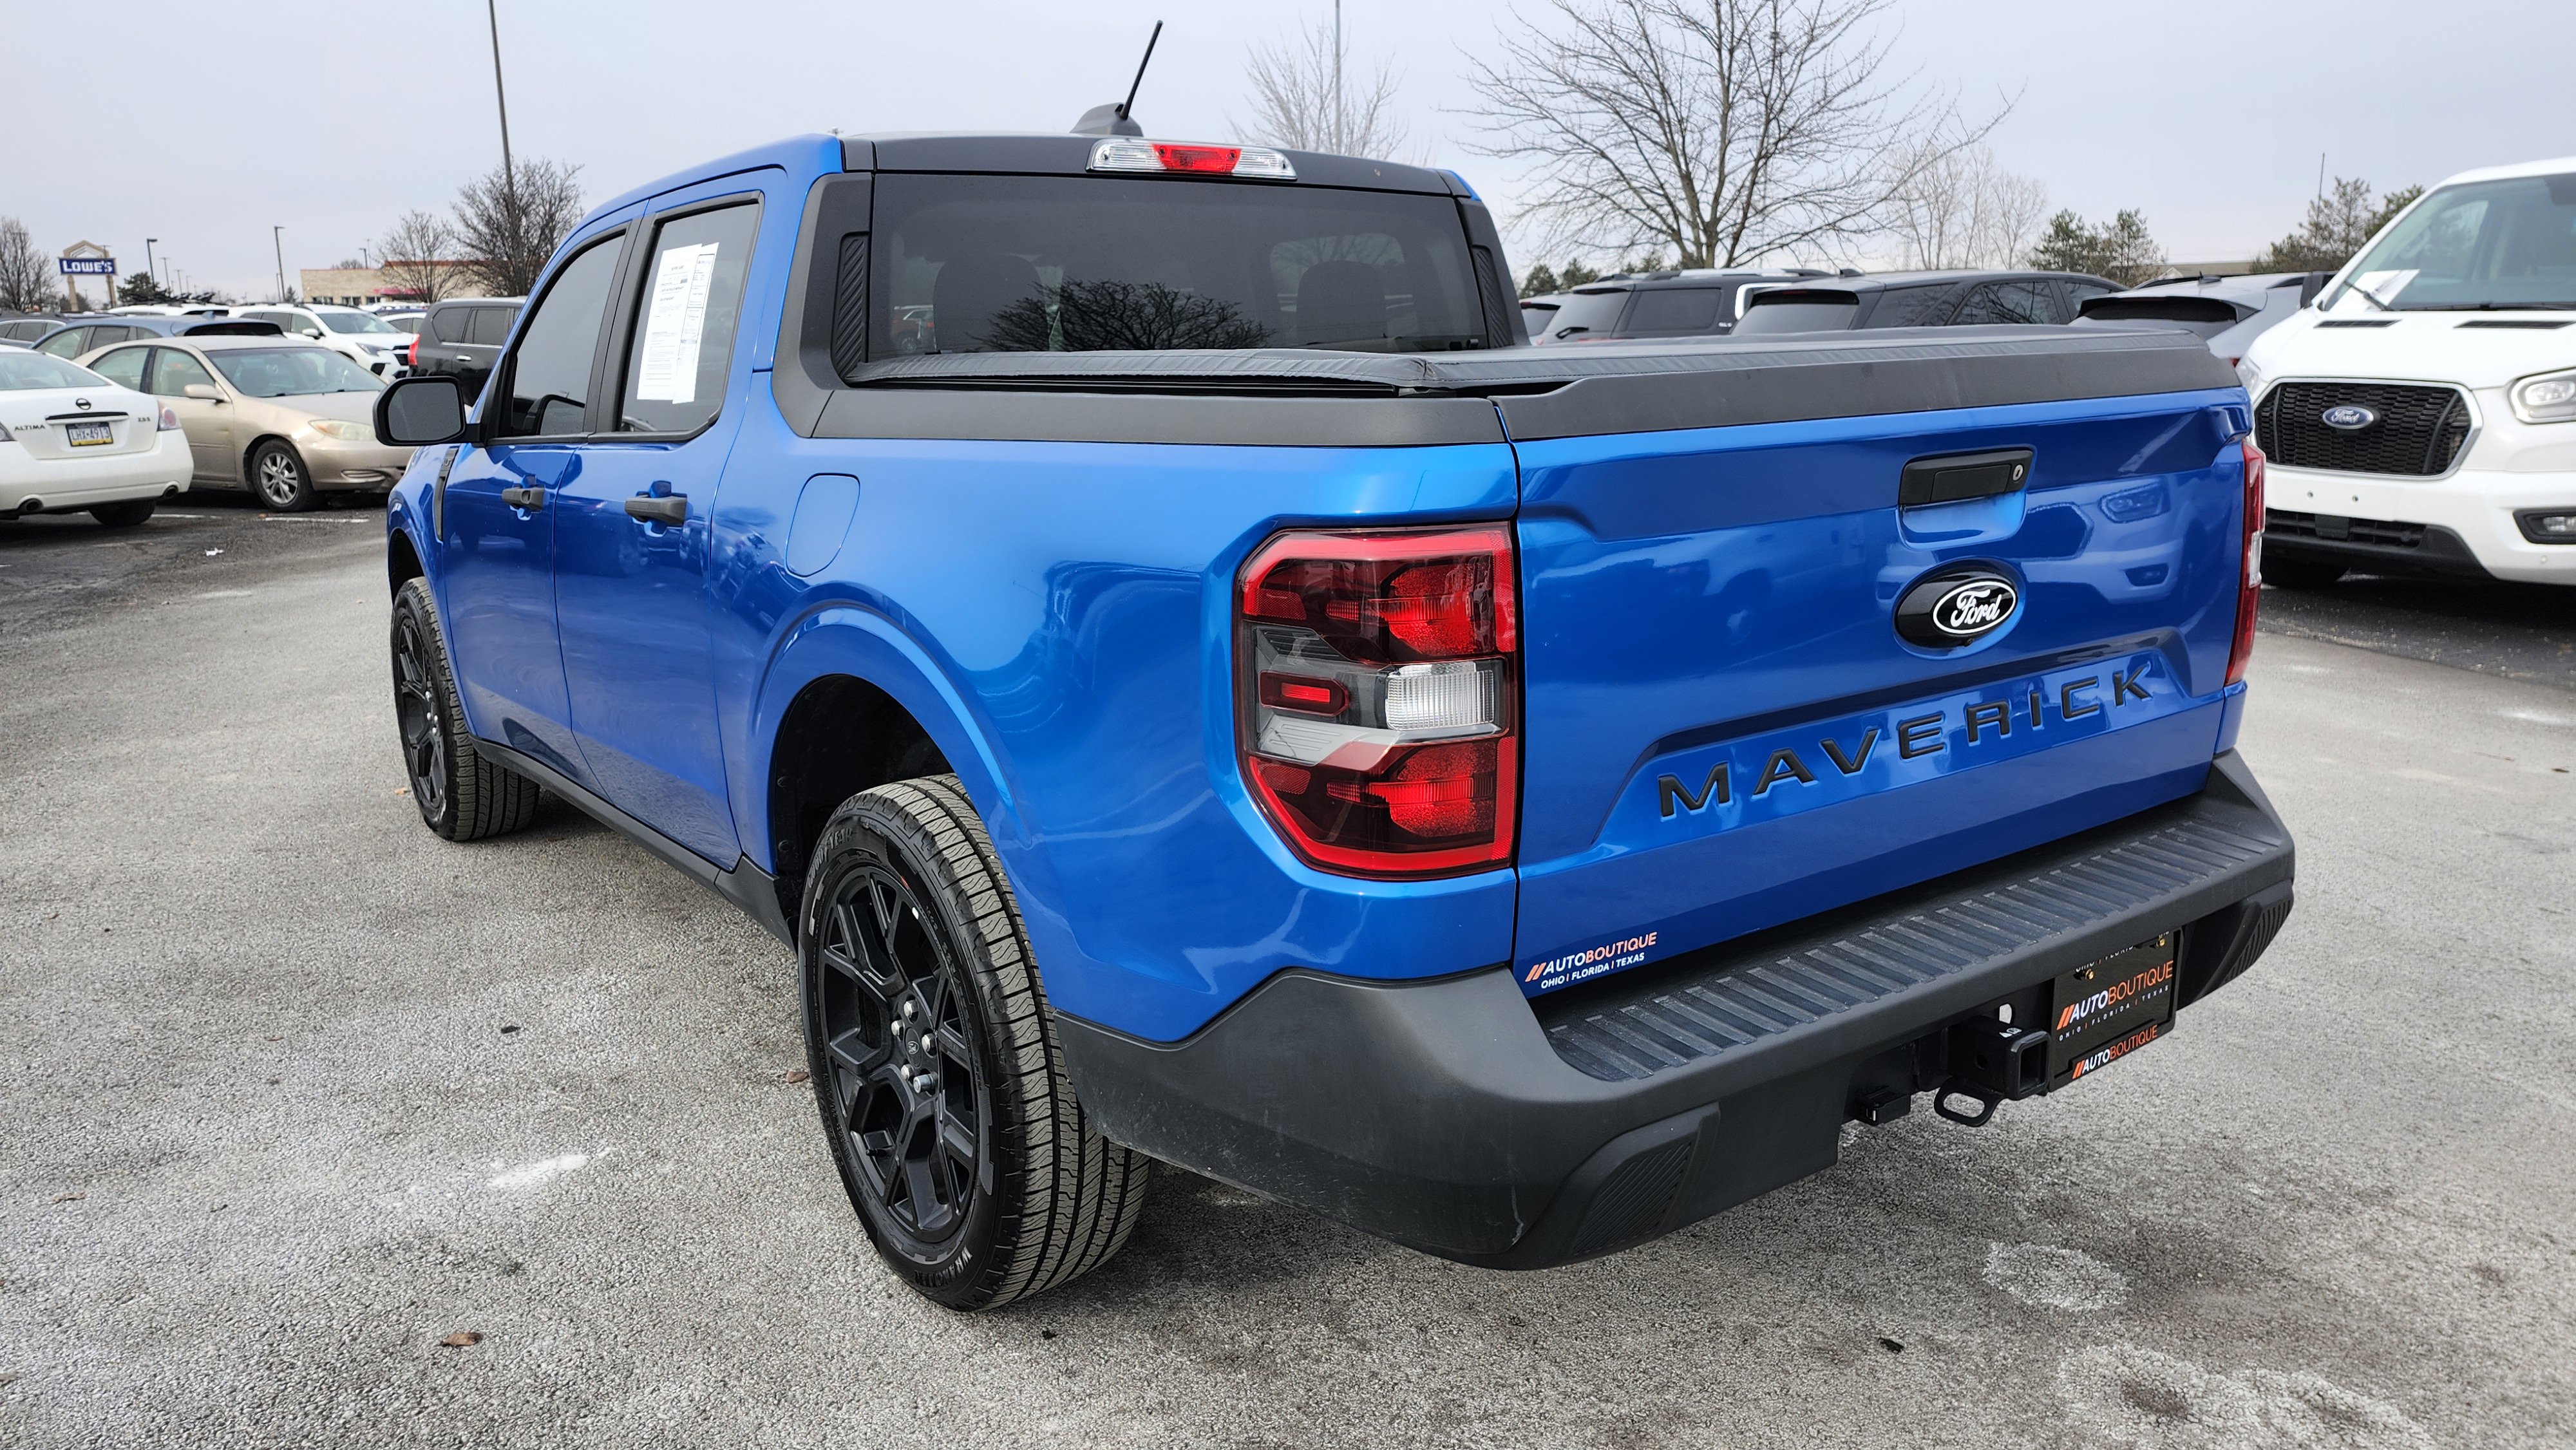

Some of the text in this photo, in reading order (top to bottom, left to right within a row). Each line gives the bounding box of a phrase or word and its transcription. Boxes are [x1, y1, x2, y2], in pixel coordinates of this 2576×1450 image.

[62, 259, 113, 273] LOWE'S
[1950, 588, 2002, 627] Ford
[1658, 662, 2152, 818] MAVERICK
[1540, 952, 1645, 989] OHIO FLORIDA TEXAS
[2059, 984, 2170, 1041] OHIO FLORIDA TEXAS
